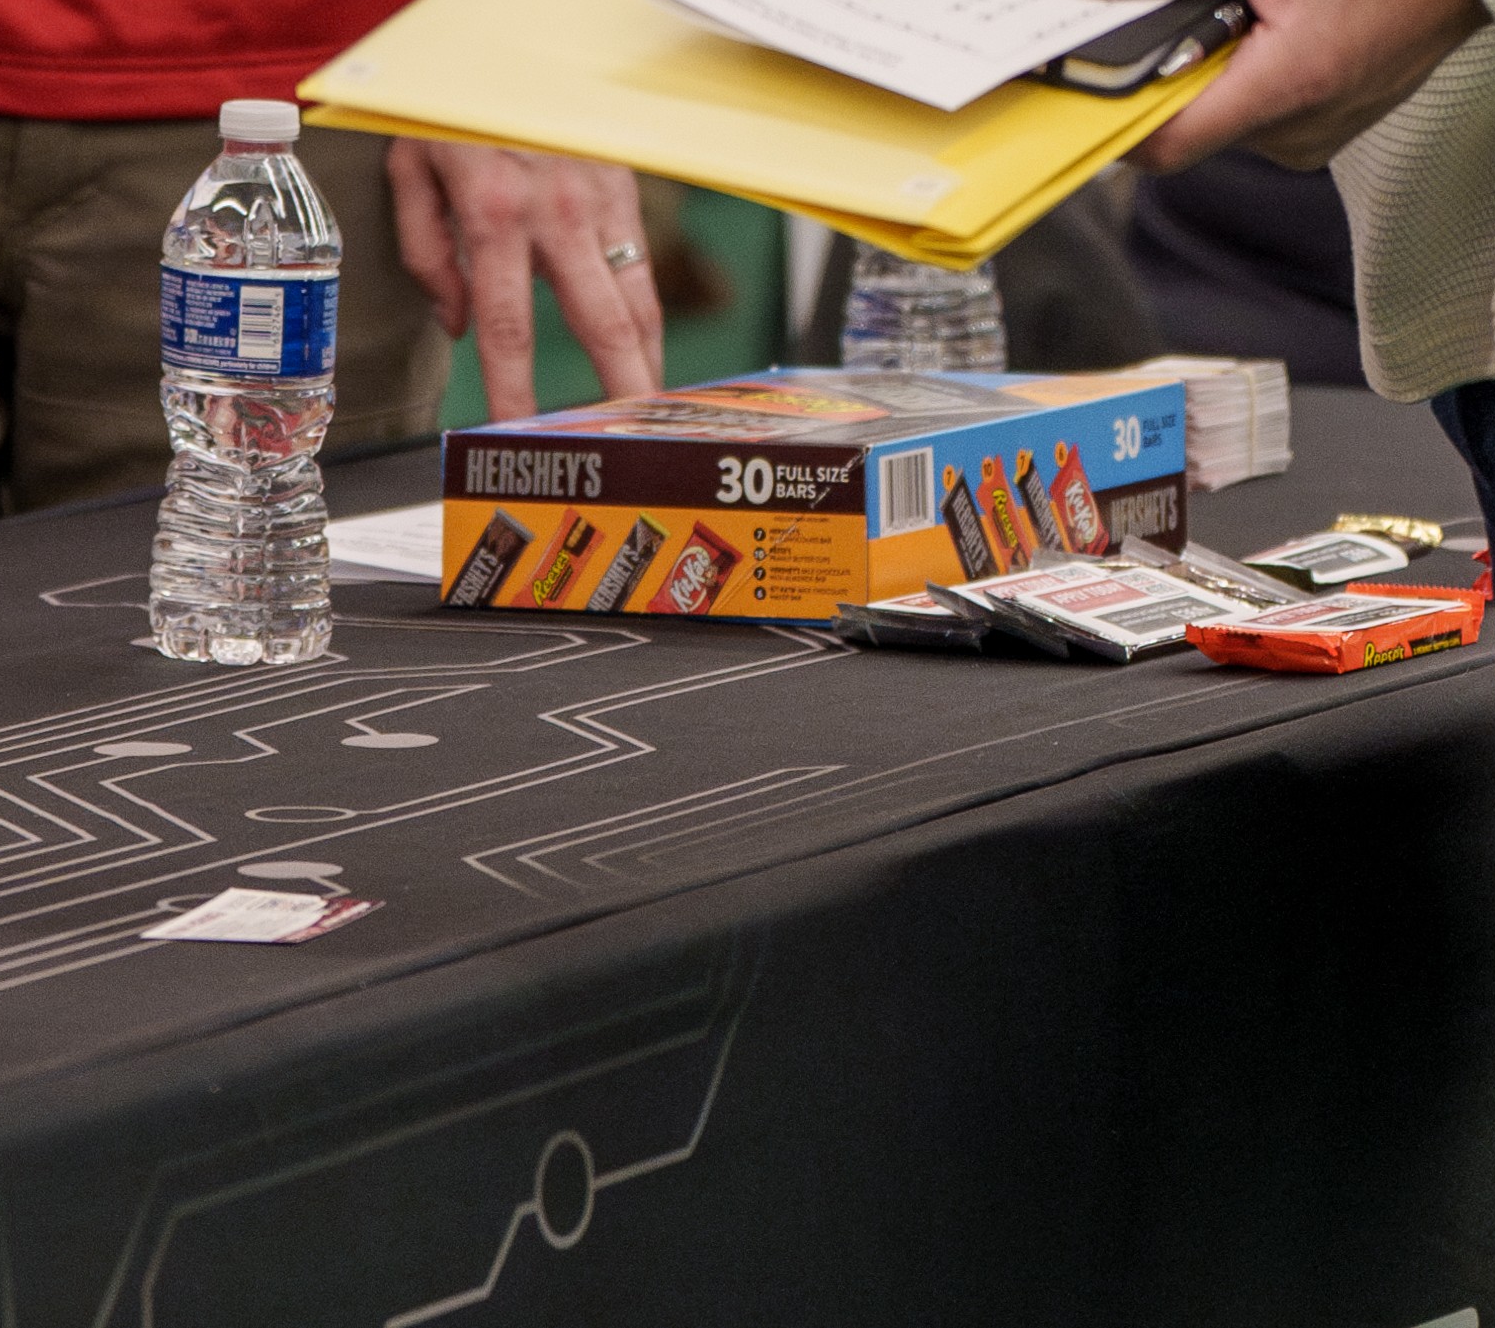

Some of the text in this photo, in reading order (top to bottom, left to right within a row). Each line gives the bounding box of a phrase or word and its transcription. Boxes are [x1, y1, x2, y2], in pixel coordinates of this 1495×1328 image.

[1112, 415, 1142, 462] 30
[466, 448, 603, 499] HERSHEY'S
[715, 456, 851, 506] 30 FULL SIZE
[775, 483, 818, 500] BARS
